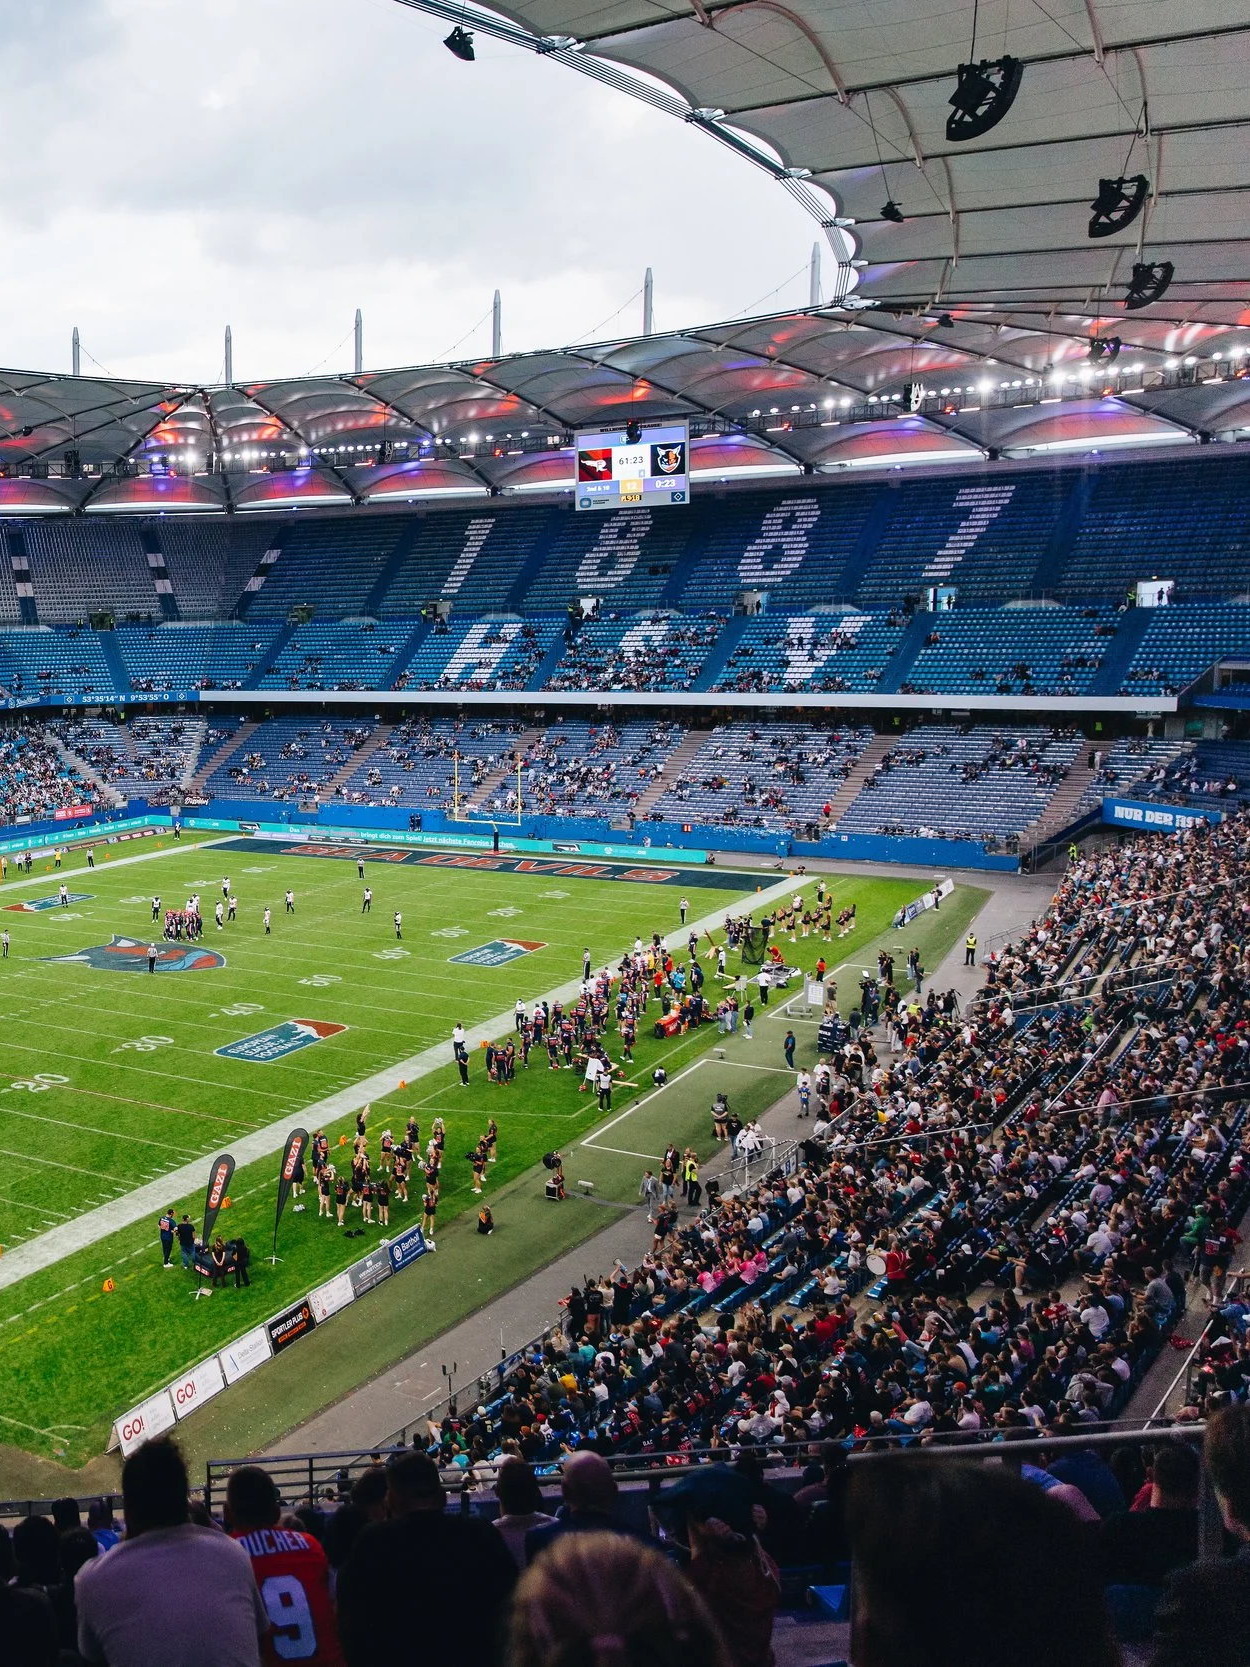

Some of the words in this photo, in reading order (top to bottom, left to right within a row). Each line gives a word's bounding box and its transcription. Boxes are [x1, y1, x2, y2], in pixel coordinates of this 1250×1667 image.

[619, 456, 644, 465] 61:23
[655, 480, 676, 489] 0:23
[119, 694, 126, 702] N
[1114, 806, 1143, 821] NUR
[1145, 810, 1173, 826] DER
[361, 832, 378, 840] bringt
[379, 832, 391, 840] dich
[281, 844, 412, 863] SEA
[414, 854, 680, 882] DEVILS
[373, 947, 411, 960] 40
[297, 973, 343, 987] 50
[220, 1002, 265, 1017] 40
[123, 1034, 175, 1052] 30
[10, 1073, 70, 1094] 20
[210, 1167, 228, 1204] GAZI
[271, 1319, 293, 1339] SPORTLER
[177, 1380, 197, 1404] GO!
[122, 1415, 145, 1441] GO!
[262, 1574, 318, 1660] 9
